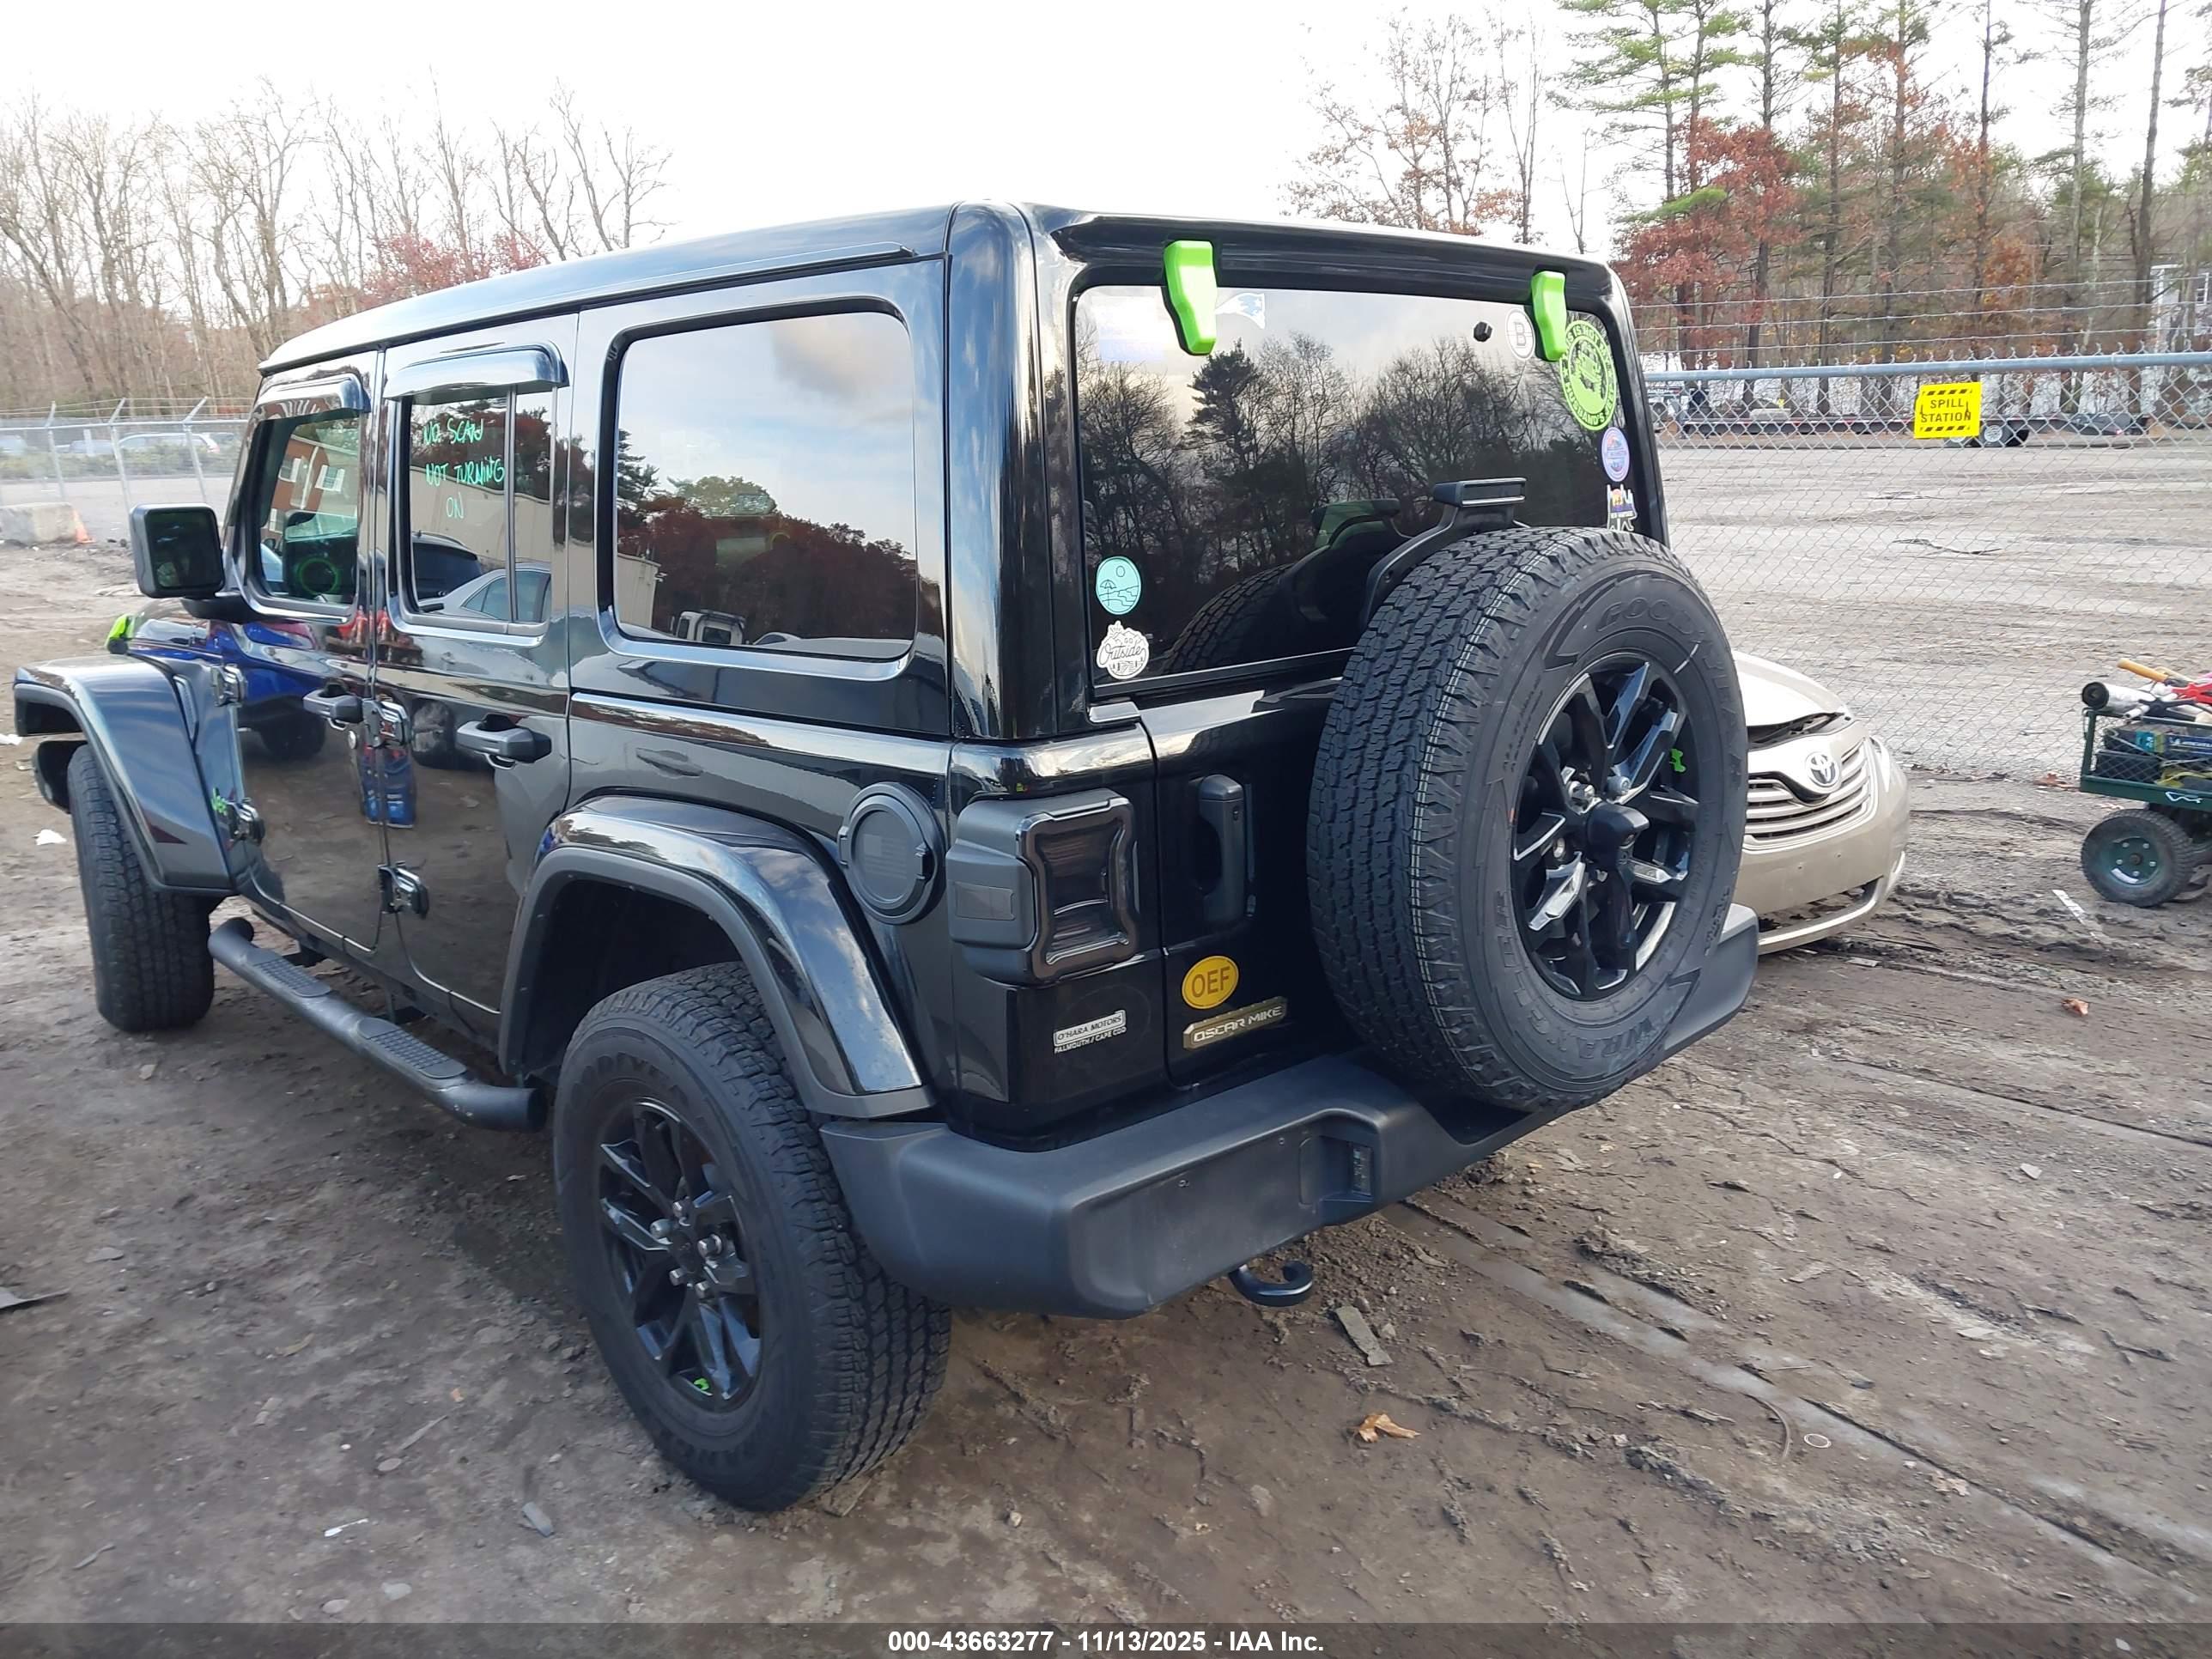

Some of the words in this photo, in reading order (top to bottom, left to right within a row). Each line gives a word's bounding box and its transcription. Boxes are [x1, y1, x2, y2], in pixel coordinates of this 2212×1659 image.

[1514, 321, 1527, 347] B
[1583, 326, 1599, 343] NOT
[1929, 398, 1965, 410] SPILL
[1920, 412, 1972, 423] STATION
[425, 463, 449, 487] NOT
[446, 491, 465, 520] ON
[1099, 640, 1146, 665] Outside
[1192, 966, 1231, 998] OEF
[1057, 1026, 1088, 1041] O'HARA
[1091, 1015, 1122, 1030] MOTORS
[1194, 1018, 1246, 1042] OSCAR
[1249, 1006, 1283, 1024] MIKE
[1054, 1037, 1091, 1054] FALMOUTH
[1095, 1030, 1113, 1042] CAPE
[1112, 1026, 1127, 1036] COD
